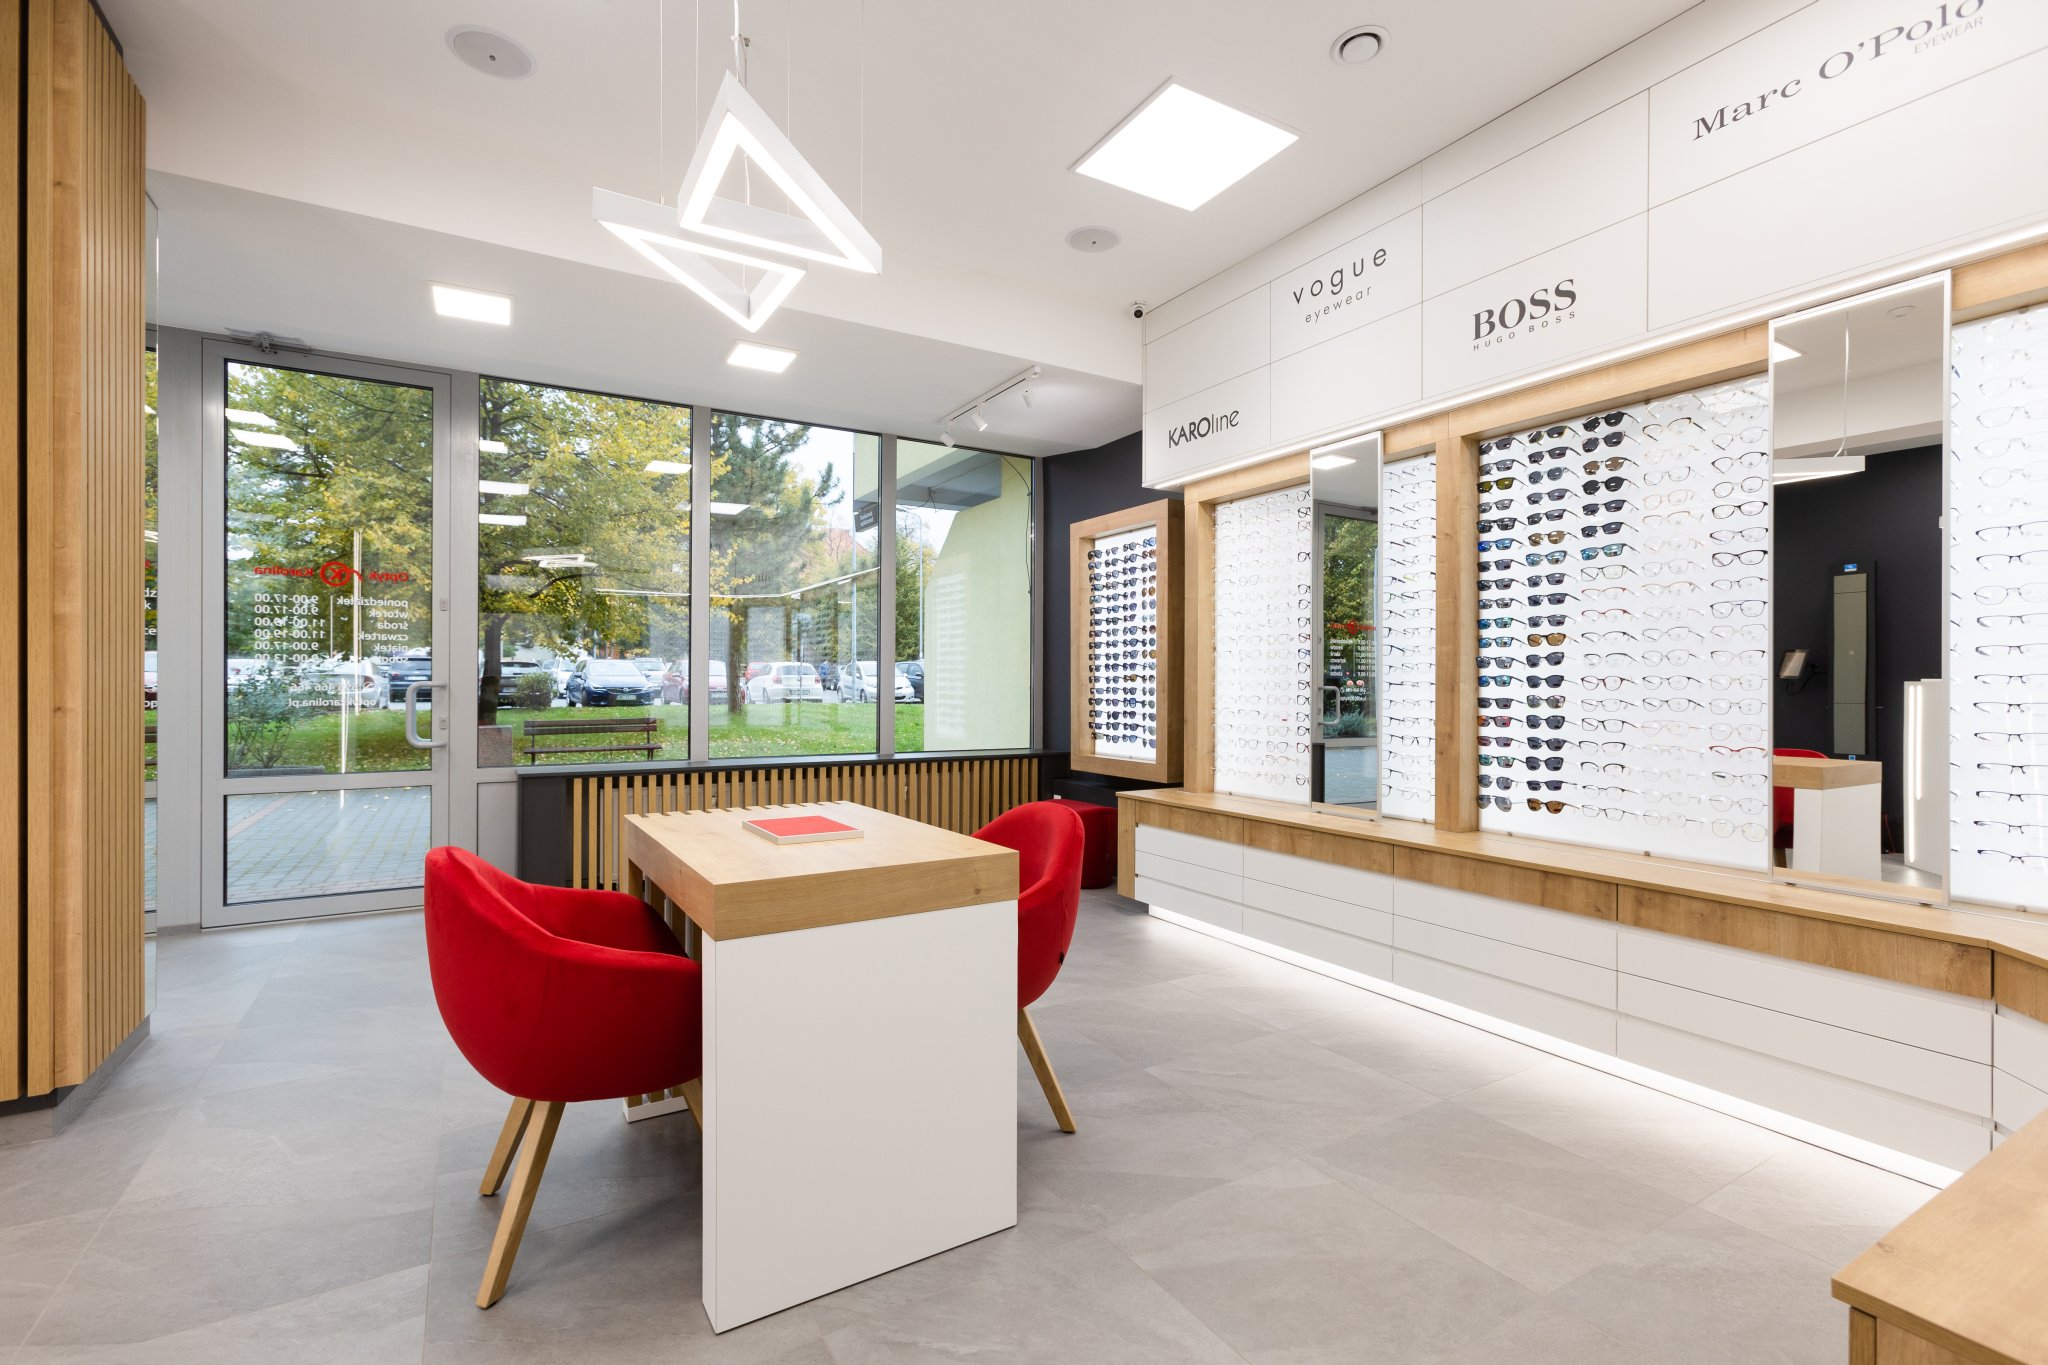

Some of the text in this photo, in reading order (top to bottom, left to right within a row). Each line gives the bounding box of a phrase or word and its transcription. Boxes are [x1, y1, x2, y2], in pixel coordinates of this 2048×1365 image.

[1914, 15, 1984, 55] EYEWEAR
[1692, 78, 1802, 141] Marc
[1292, 247, 1387, 305] vogue
[1305, 285, 1373, 324] eyewear
[1472, 278, 1577, 341] BOSS
[1473, 310, 1576, 352] HUGO BOSS
[1168, 409, 1239, 449] KAROline
